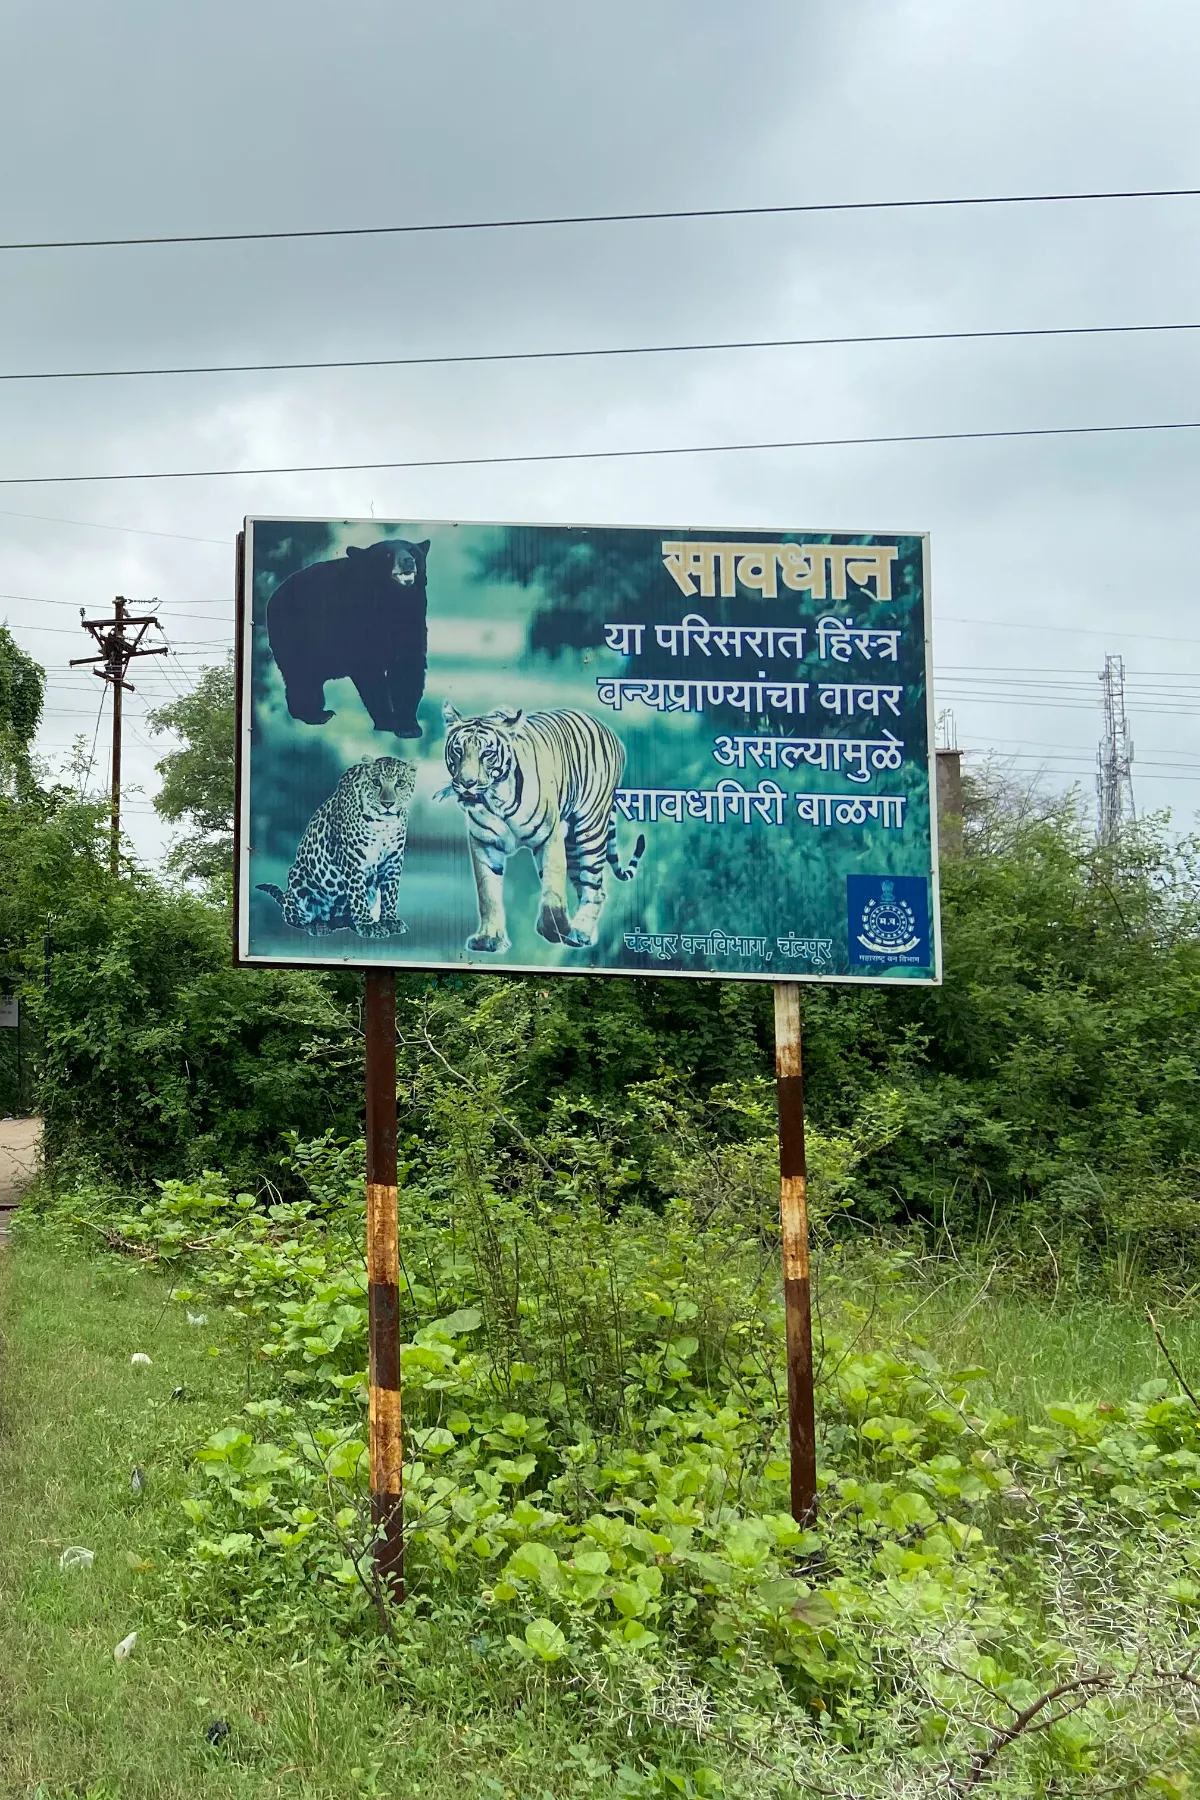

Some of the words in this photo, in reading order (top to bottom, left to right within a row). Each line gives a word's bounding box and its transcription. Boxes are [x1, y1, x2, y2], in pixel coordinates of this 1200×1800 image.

[604, 624, 645, 656] या
[655, 613, 806, 659] परिसरात
[597, 670, 809, 714] वन्यप्राण्यांचा
[818, 683, 903, 716] वावर
[713, 729, 904, 783] असल्यामुळे
[614, 778, 787, 826] सावधगिरी
[796, 793, 906, 828] बाळगा
[624, 926, 678, 960] चंद्रपूर
[777, 931, 832, 965] चंद्रपूर
